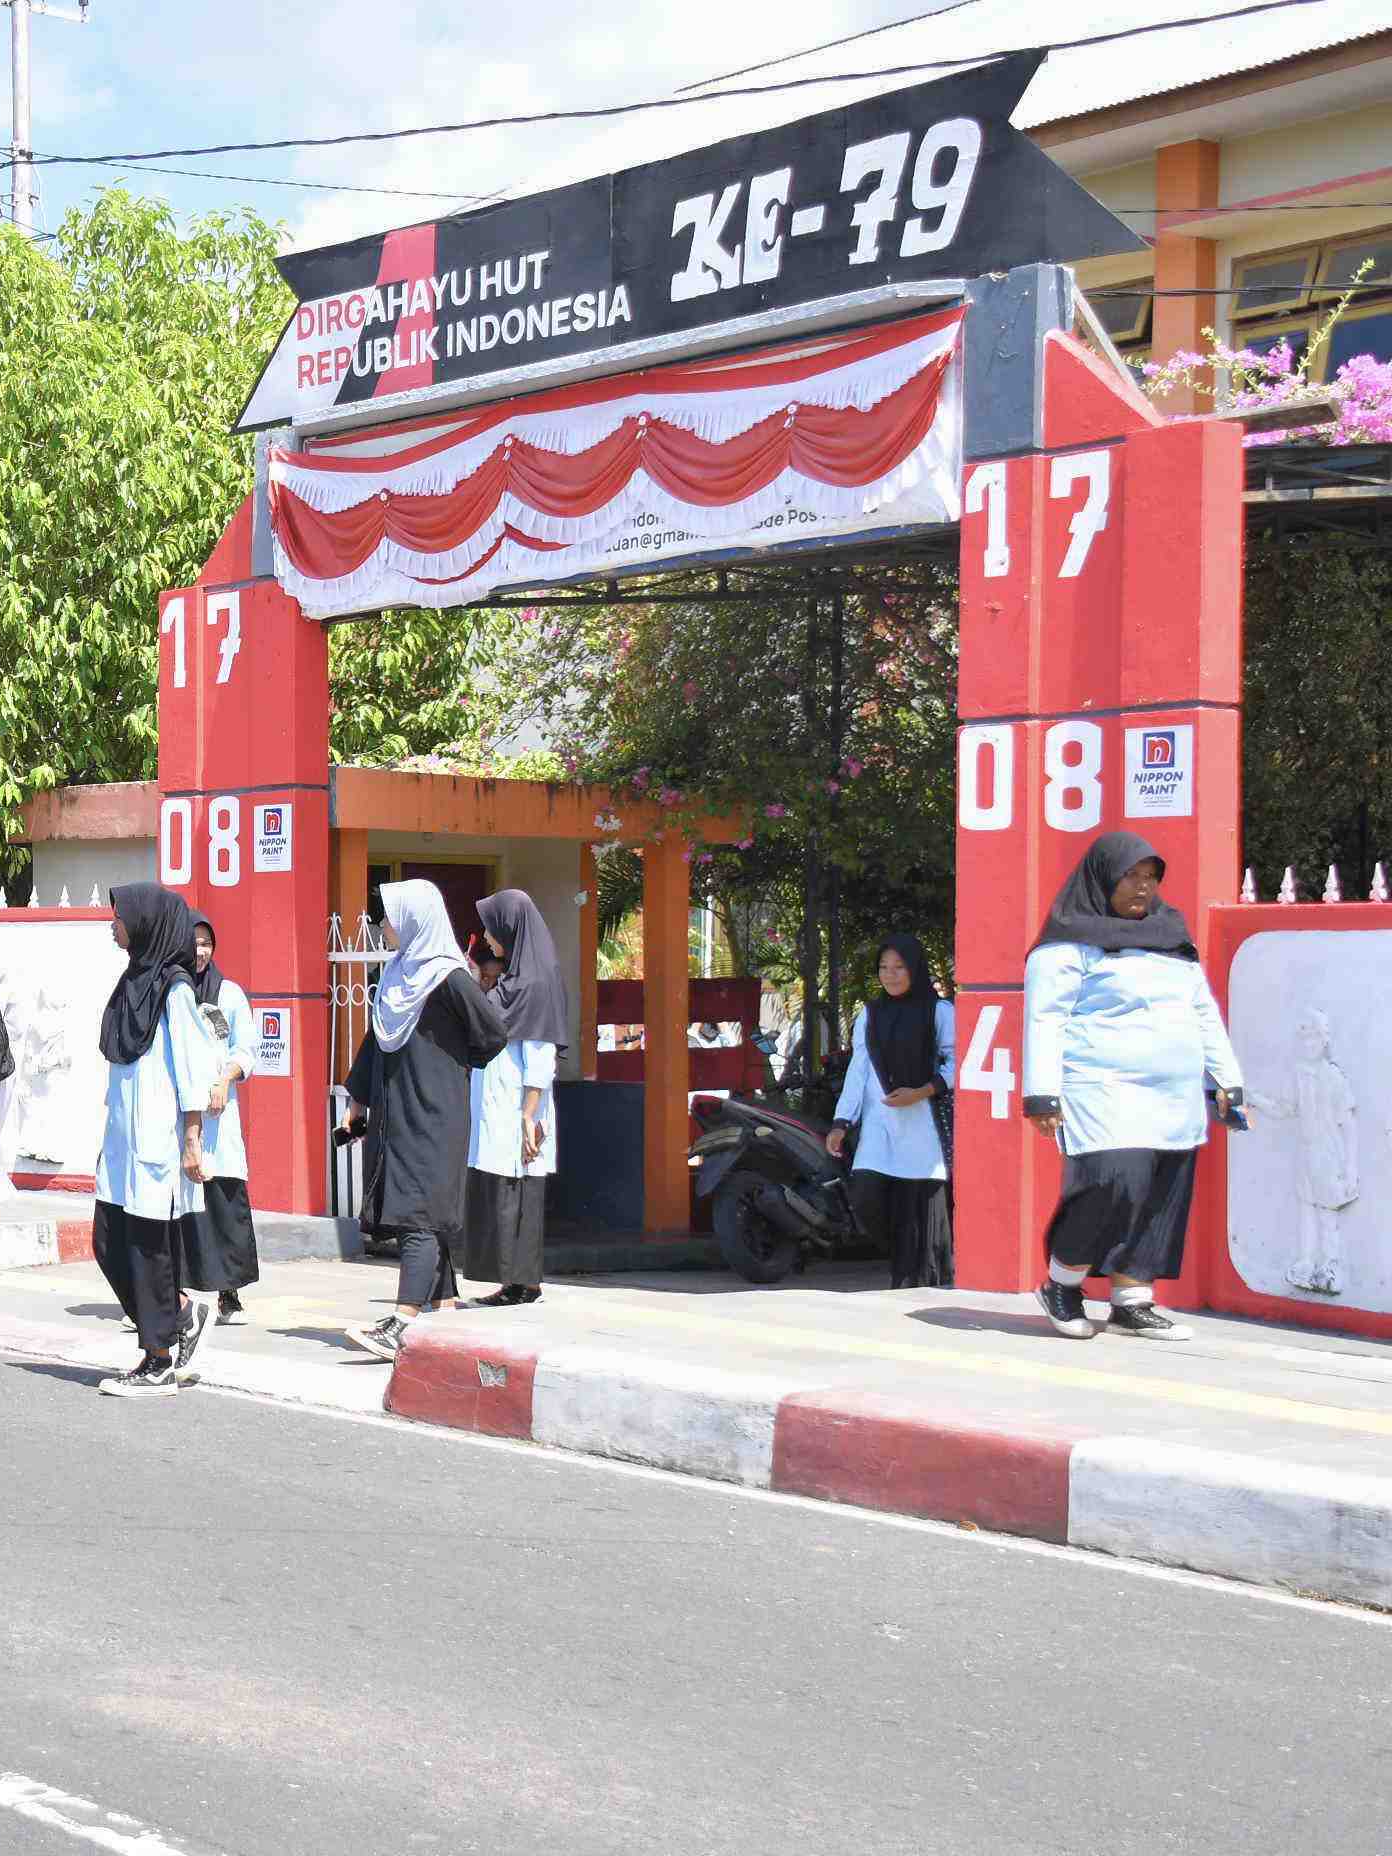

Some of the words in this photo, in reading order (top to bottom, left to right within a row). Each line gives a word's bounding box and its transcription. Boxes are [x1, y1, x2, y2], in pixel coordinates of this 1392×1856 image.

[671, 118, 982, 302] KE-79
[296, 268, 472, 341] DIRGAHAYU
[480, 251, 550, 300] HUT
[297, 325, 441, 390] REPUBLIK
[447, 284, 633, 358] INDONESIA
[959, 721, 1103, 832] 08
[1133, 771, 1184, 783] NIPPON
[1139, 784, 1178, 795] PAINT
[161, 796, 241, 887] 08
[258, 837, 287, 847] NIPPON
[262, 846, 284, 856] PAINT
[261, 1051, 281, 1060] PAINT
